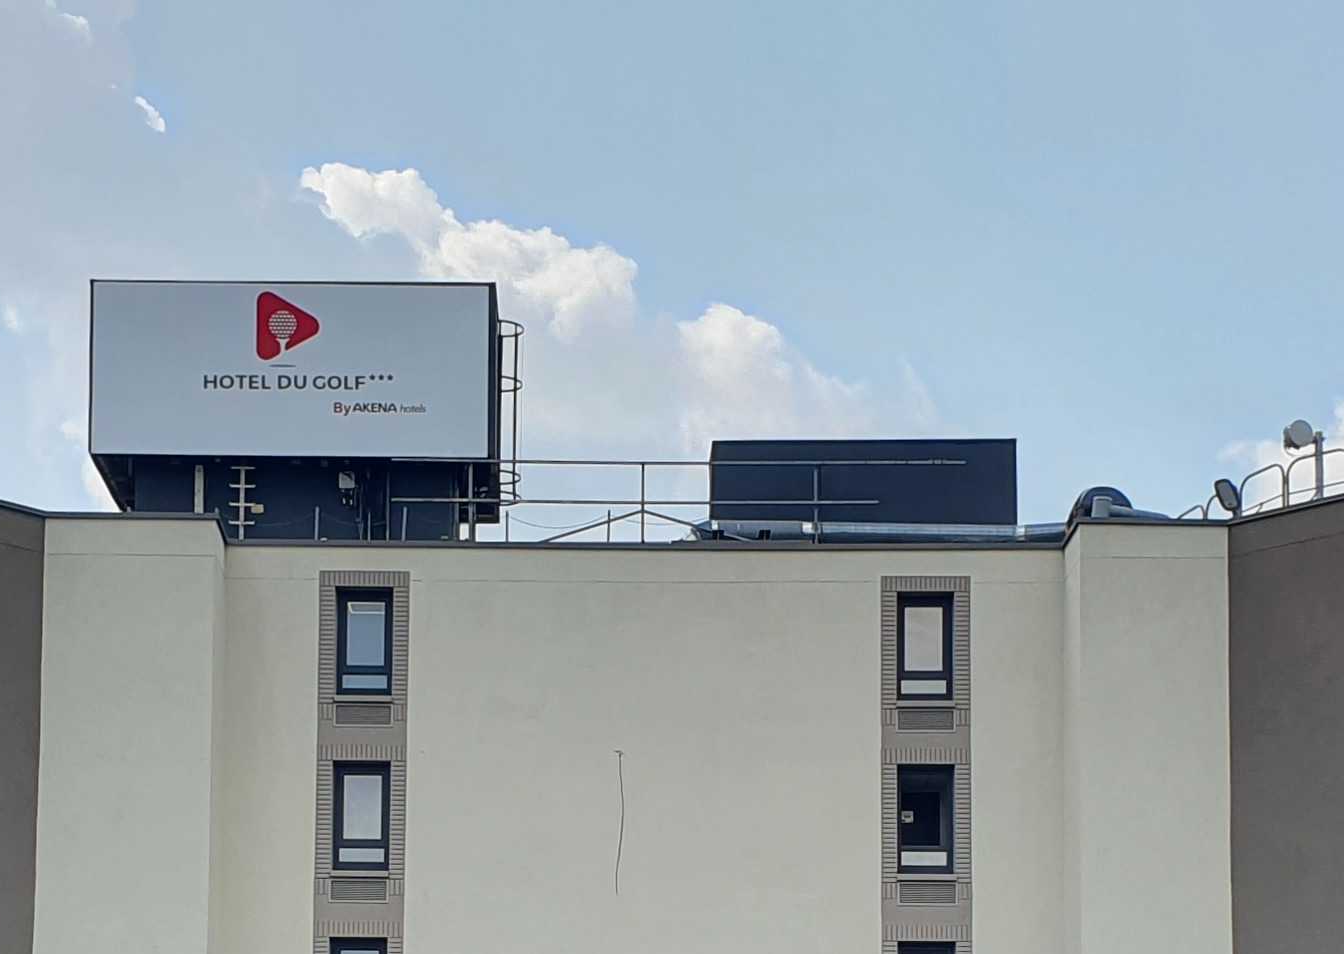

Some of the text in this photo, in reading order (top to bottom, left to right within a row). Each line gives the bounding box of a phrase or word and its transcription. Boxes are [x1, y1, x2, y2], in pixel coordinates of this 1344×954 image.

[203, 375, 366, 391] HOTEL DU GOLF
[333, 402, 427, 416] By AKENA hotels
